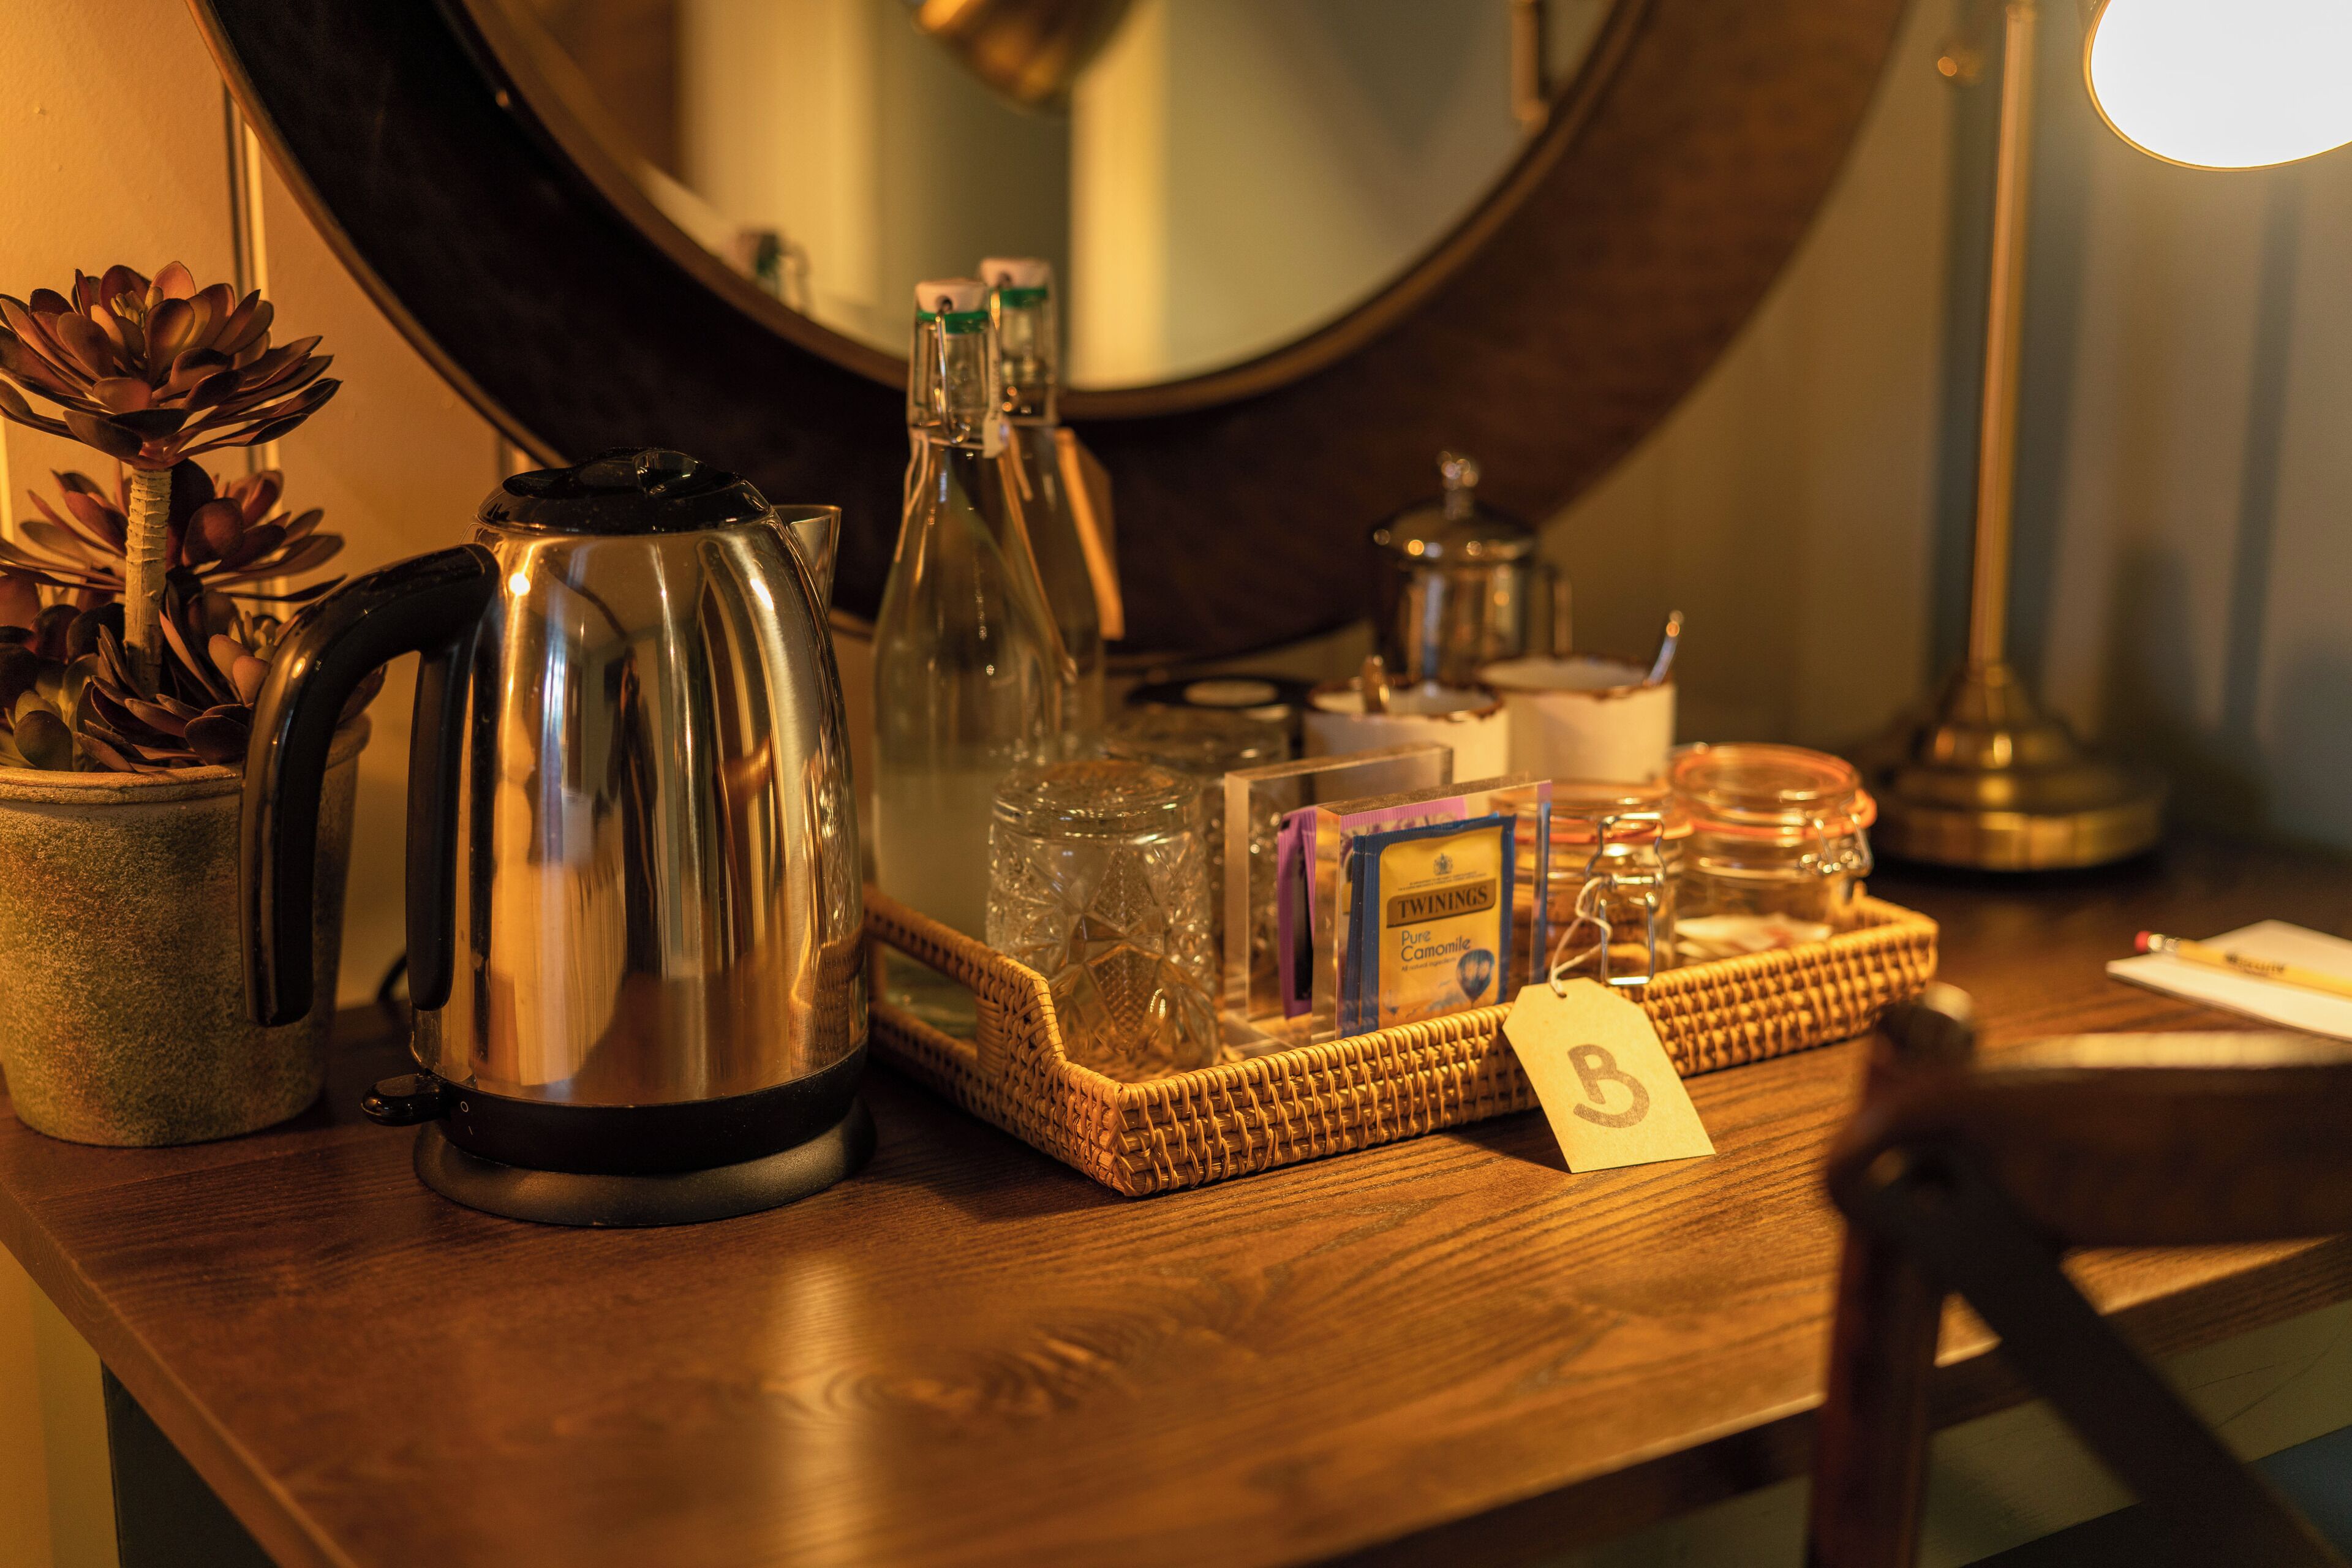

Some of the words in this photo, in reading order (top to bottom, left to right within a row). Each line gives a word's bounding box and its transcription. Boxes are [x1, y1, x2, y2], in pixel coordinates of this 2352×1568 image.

[1398, 886, 1487, 918] TWININGS
[1401, 930, 1431, 946] Pure
[1401, 935, 1471, 962] Camomile
[1409, 962, 1428, 970] natural
[1567, 1044, 1650, 1128] B
